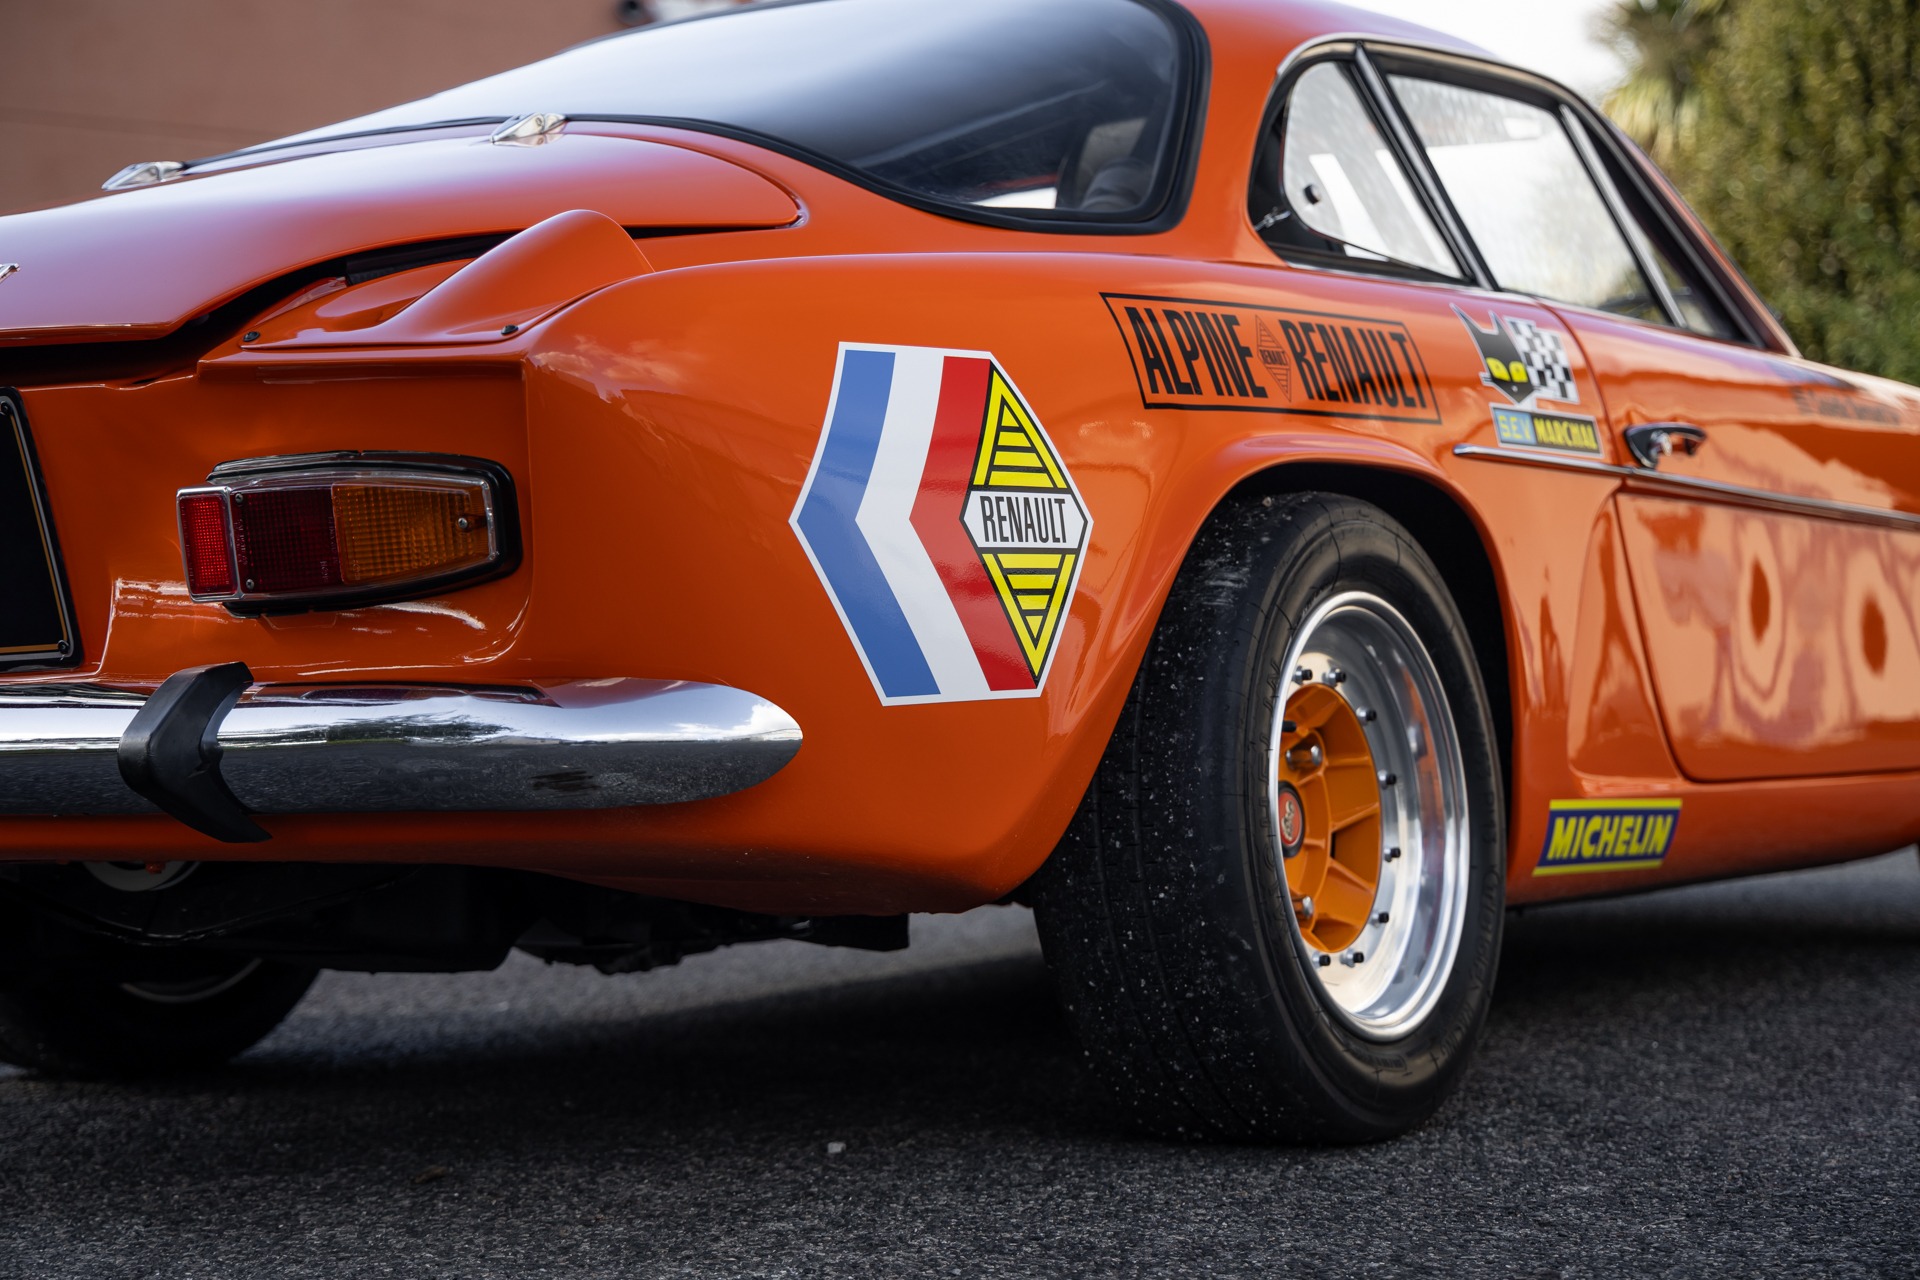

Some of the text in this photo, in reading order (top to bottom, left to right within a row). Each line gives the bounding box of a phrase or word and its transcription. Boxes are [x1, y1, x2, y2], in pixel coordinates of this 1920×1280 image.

[1124, 306, 1428, 409] ALPINE RENAULT
[1498, 415, 1598, 450] SEV MARCHAL
[979, 495, 1067, 544] RENAULT
[1546, 815, 1674, 860] MICHELIN
